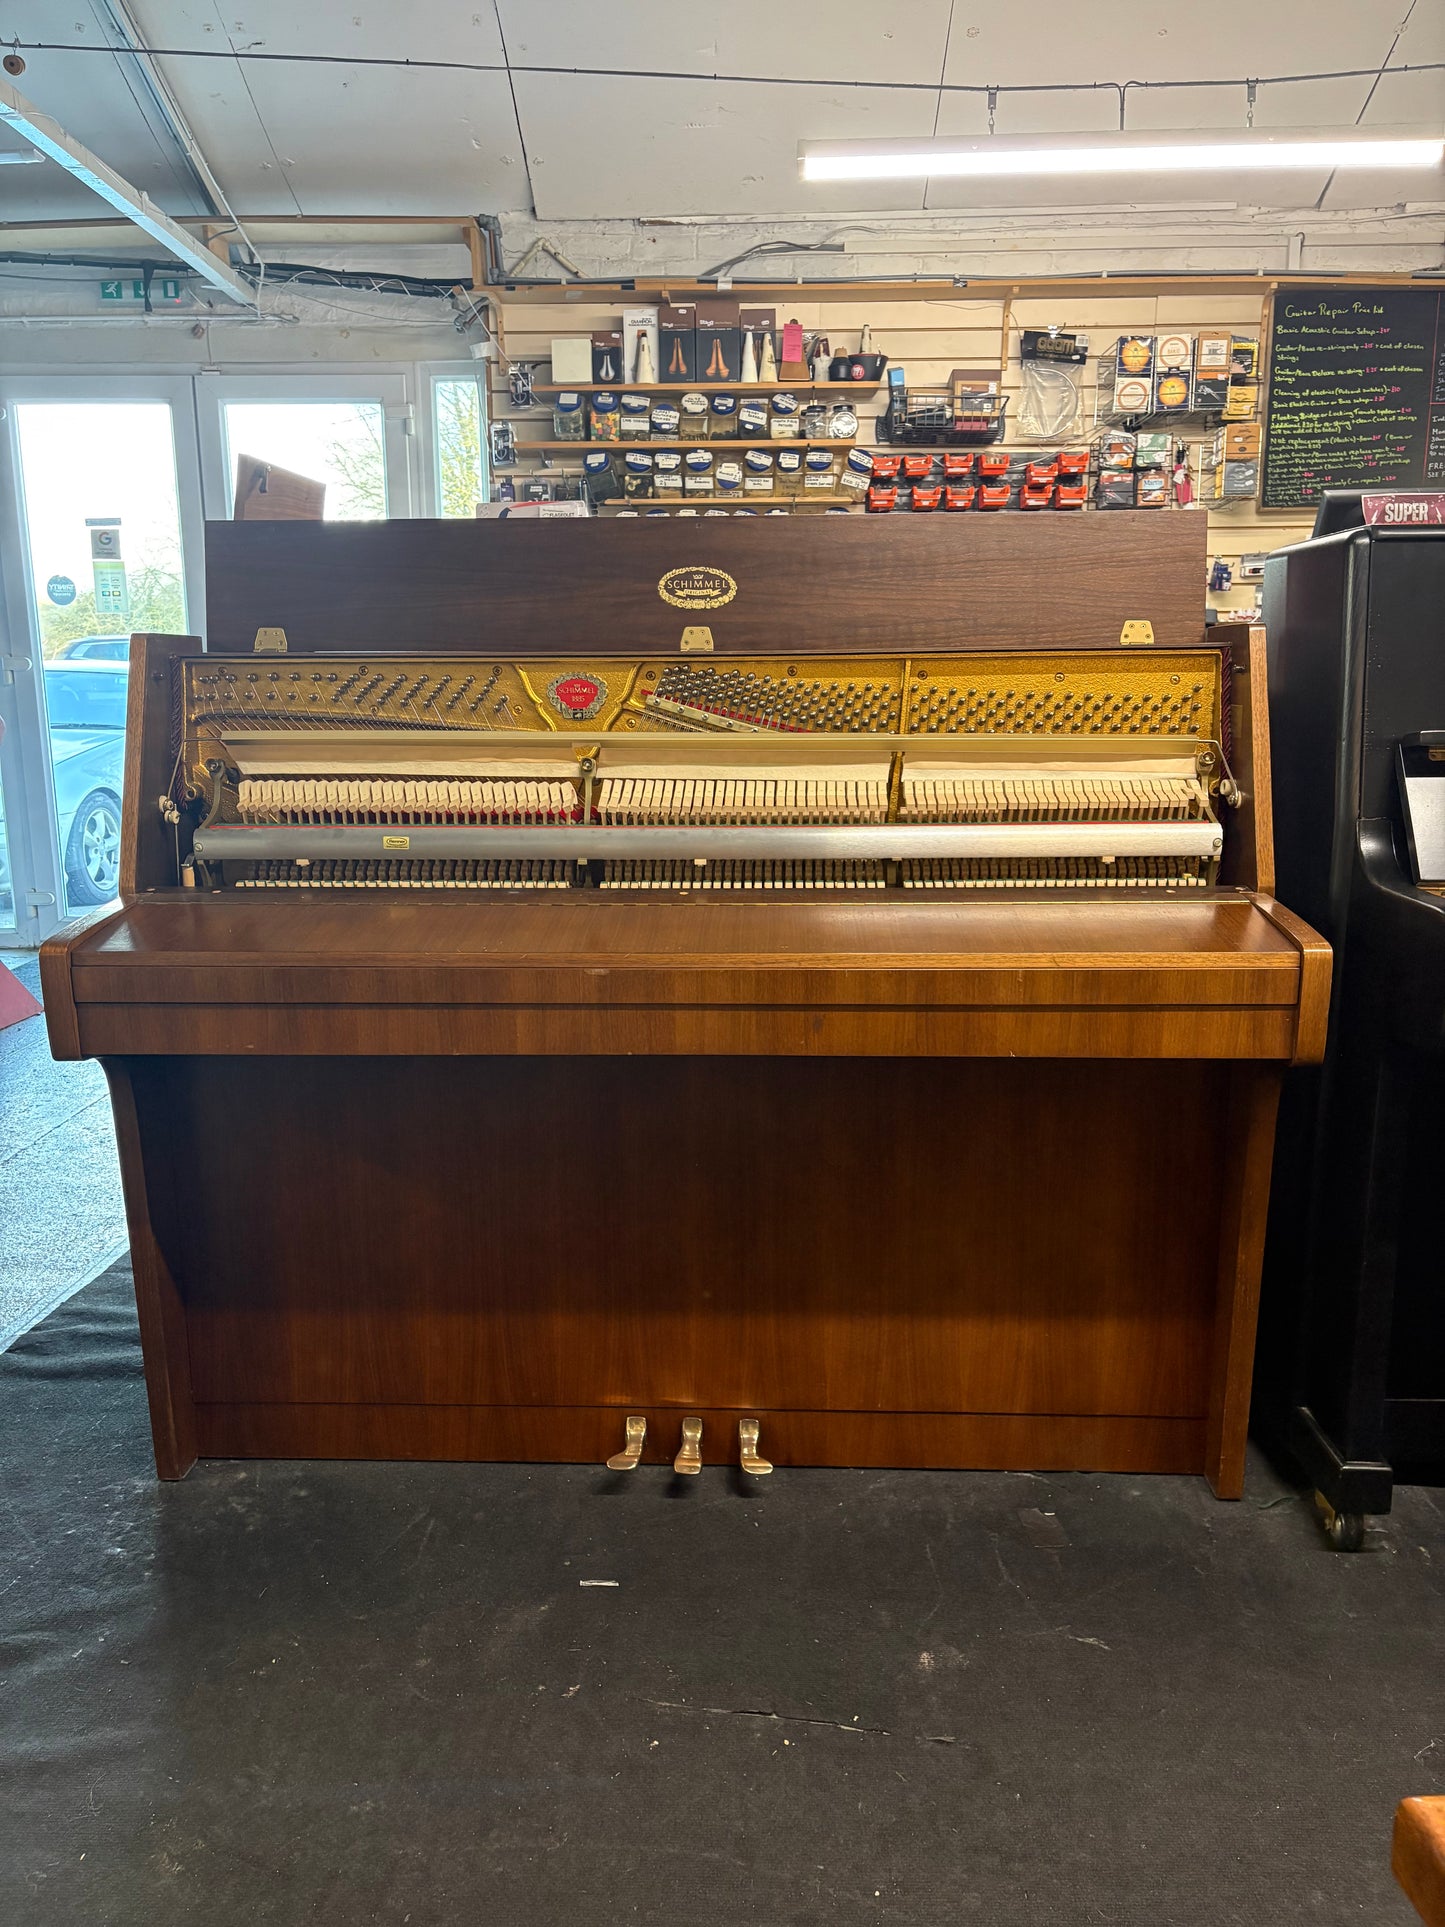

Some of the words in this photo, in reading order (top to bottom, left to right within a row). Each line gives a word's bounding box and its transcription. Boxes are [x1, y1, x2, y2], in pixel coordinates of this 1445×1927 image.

[1285, 305, 1317, 318] Guitar
[1319, 302, 1349, 319] Repair
[1352, 302, 1370, 314] Price
[1276, 325, 1299, 334] Basic
[1301, 326, 1330, 334] Acoustic
[1273, 389, 1300, 398] Cleaning
[1428, 462, 1445, 470] FRE
[1384, 502, 1429, 523] SUPER
[667, 579, 728, 589] SCHIMMEL
